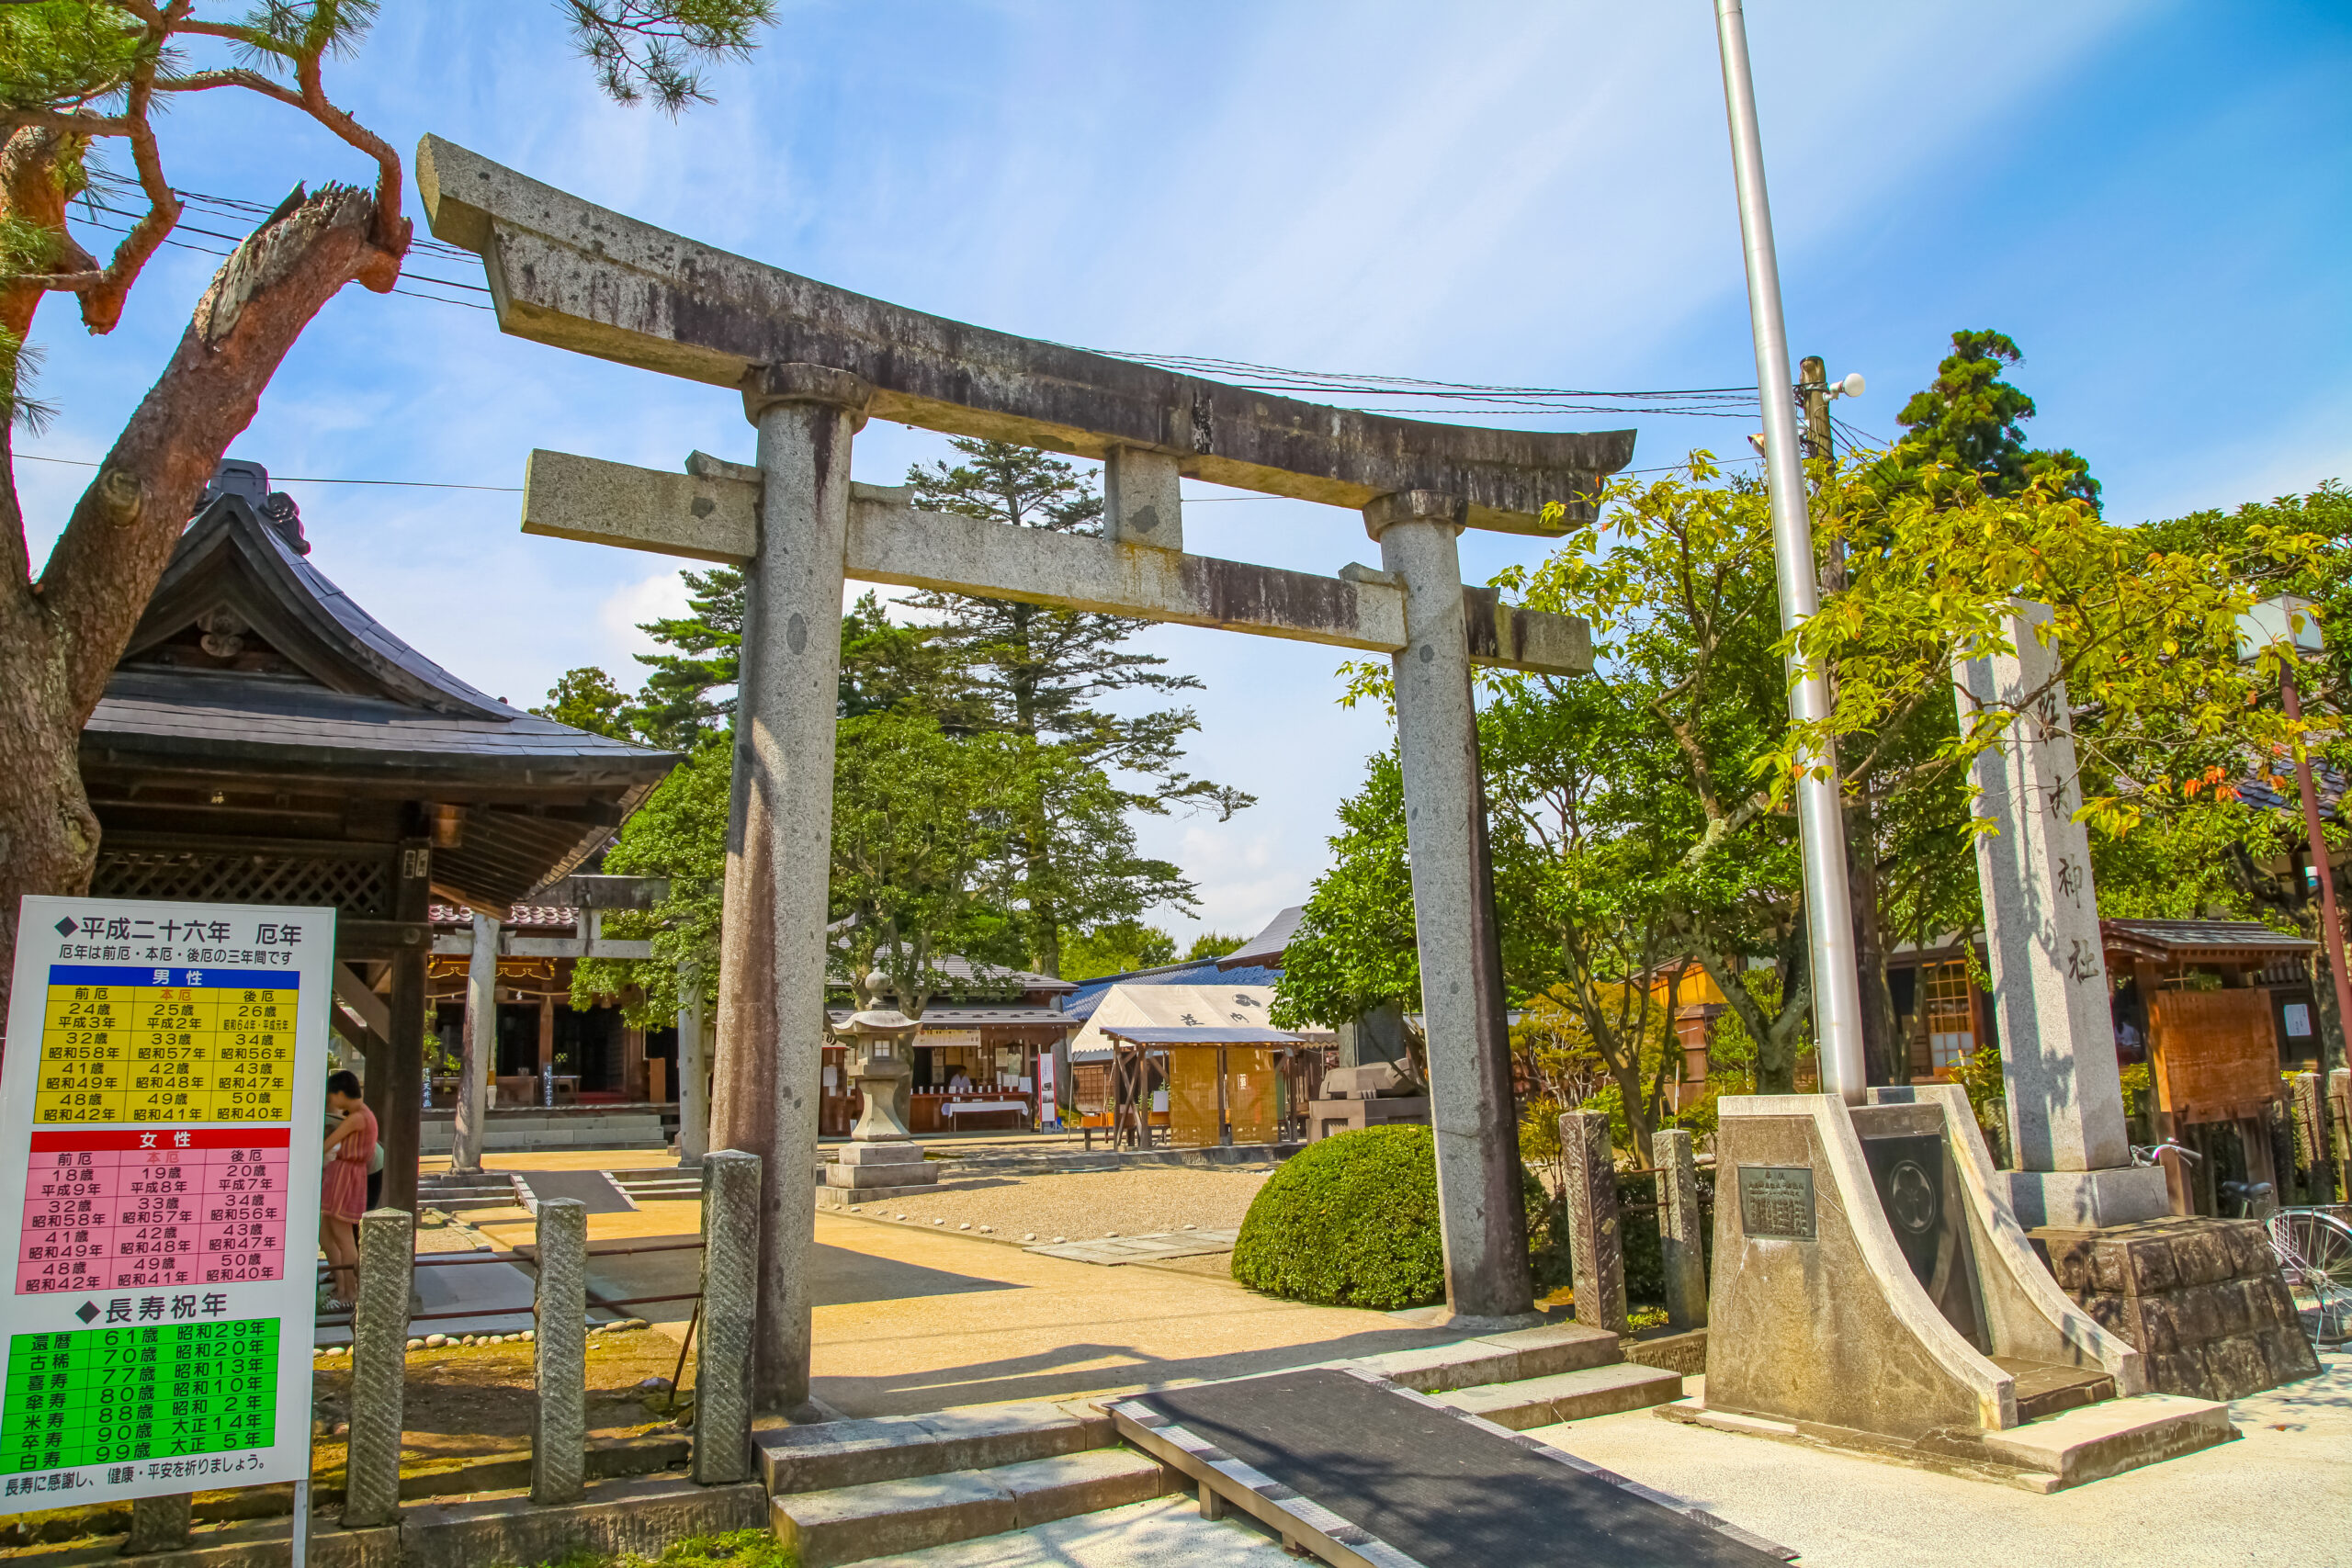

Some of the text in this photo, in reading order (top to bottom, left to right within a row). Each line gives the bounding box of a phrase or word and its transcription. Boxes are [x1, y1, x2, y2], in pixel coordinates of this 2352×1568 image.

[80, 917, 302, 947] 平成二十六年 厄年
[59, 944, 293, 964] 厄年は前厄・本厄・後厄の三年間です
[153, 969, 203, 986] 男性
[74, 987, 108, 1000] 前厄
[160, 988, 192, 1001] 本厄
[243, 990, 275, 1002] 後厄
[69, 1003, 110, 1015] 24歳
[154, 1004, 194, 1016] 25歳
[238, 1006, 277, 1018] 26歳
[59, 1017, 116, 1029] 平成3年
[147, 1018, 201, 1030] 平成2年
[66, 1032, 107, 1044] 32歳
[151, 1033, 192, 1045] 33歳
[235, 1033, 274, 1046] 34歳
[49, 1046, 120, 1059] 昭和58年
[138, 1047, 206, 1059] 昭和57年
[220, 1048, 287, 1059] 昭和56年
[62, 1063, 105, 1075] 41歳
[149, 1063, 189, 1075] 42歳
[233, 1063, 273, 1075] 43歳
[46, 1077, 118, 1089] 昭和49年
[136, 1077, 204, 1089] 昭和48年
[219, 1077, 285, 1089] 昭和47年
[60, 1093, 102, 1106] 48歳
[147, 1093, 187, 1105] 49歳
[232, 1092, 271, 1104] 50歳
[43, 1108, 116, 1121] 昭和42年
[133, 1109, 202, 1121] 昭和41年
[217, 1108, 283, 1120] 昭和40年
[140, 1131, 191, 1148] 女性
[58, 1152, 93, 1166] 前厄
[147, 1151, 179, 1164] 本厄
[231, 1149, 263, 1162] 後厄
[52, 1168, 95, 1182] 18歳
[141, 1167, 182, 1179] 19歳
[227, 1165, 266, 1178] 20歳
[41, 1184, 101, 1197] 平成9年
[130, 1181, 187, 1194] 平成8年
[219, 1179, 273, 1191] 平成7年
[48, 1200, 92, 1213] 32歳
[138, 1197, 179, 1210] 33歳
[224, 1194, 265, 1207] 34歳
[32, 1213, 106, 1227] 昭和58年
[122, 1211, 193, 1224] 昭和57年
[210, 1208, 277, 1221] 昭和56年
[136, 1226, 177, 1240] 42歳
[223, 1223, 263, 1236] 43歳
[45, 1229, 89, 1244] 41歳
[120, 1240, 191, 1255] 昭和48年
[209, 1236, 277, 1251] 昭和47年
[28, 1245, 103, 1259] 昭和49年
[133, 1257, 175, 1270] 49歳
[221, 1254, 261, 1267] 50歳
[42, 1261, 87, 1275] 48歳
[206, 1267, 275, 1281] 昭和40年
[26, 1276, 100, 1292] 昭和42年
[118, 1271, 188, 1286] 昭和41年
[106, 1293, 228, 1324] 長寿祝年
[30, 1321, 266, 1352] 還暦 61歳 昭和29年
[29, 1339, 265, 1371] 古稀 70歳 昭和20年
[27, 1358, 264, 1392] 喜寿 77歳 昭和13年
[25, 1376, 263, 1411] 傘寿 80歳 昭和10年
[23, 1394, 262, 1430] 米寿 88歳 昭和2年
[21, 1413, 262, 1450] 卒寿 90歳 大正14年
[19, 1431, 261, 1471] 白寿 99歳 大正5年
[4, 1453, 265, 1497] 長寿に感謝し、 健康・平安を祈りましょう。
